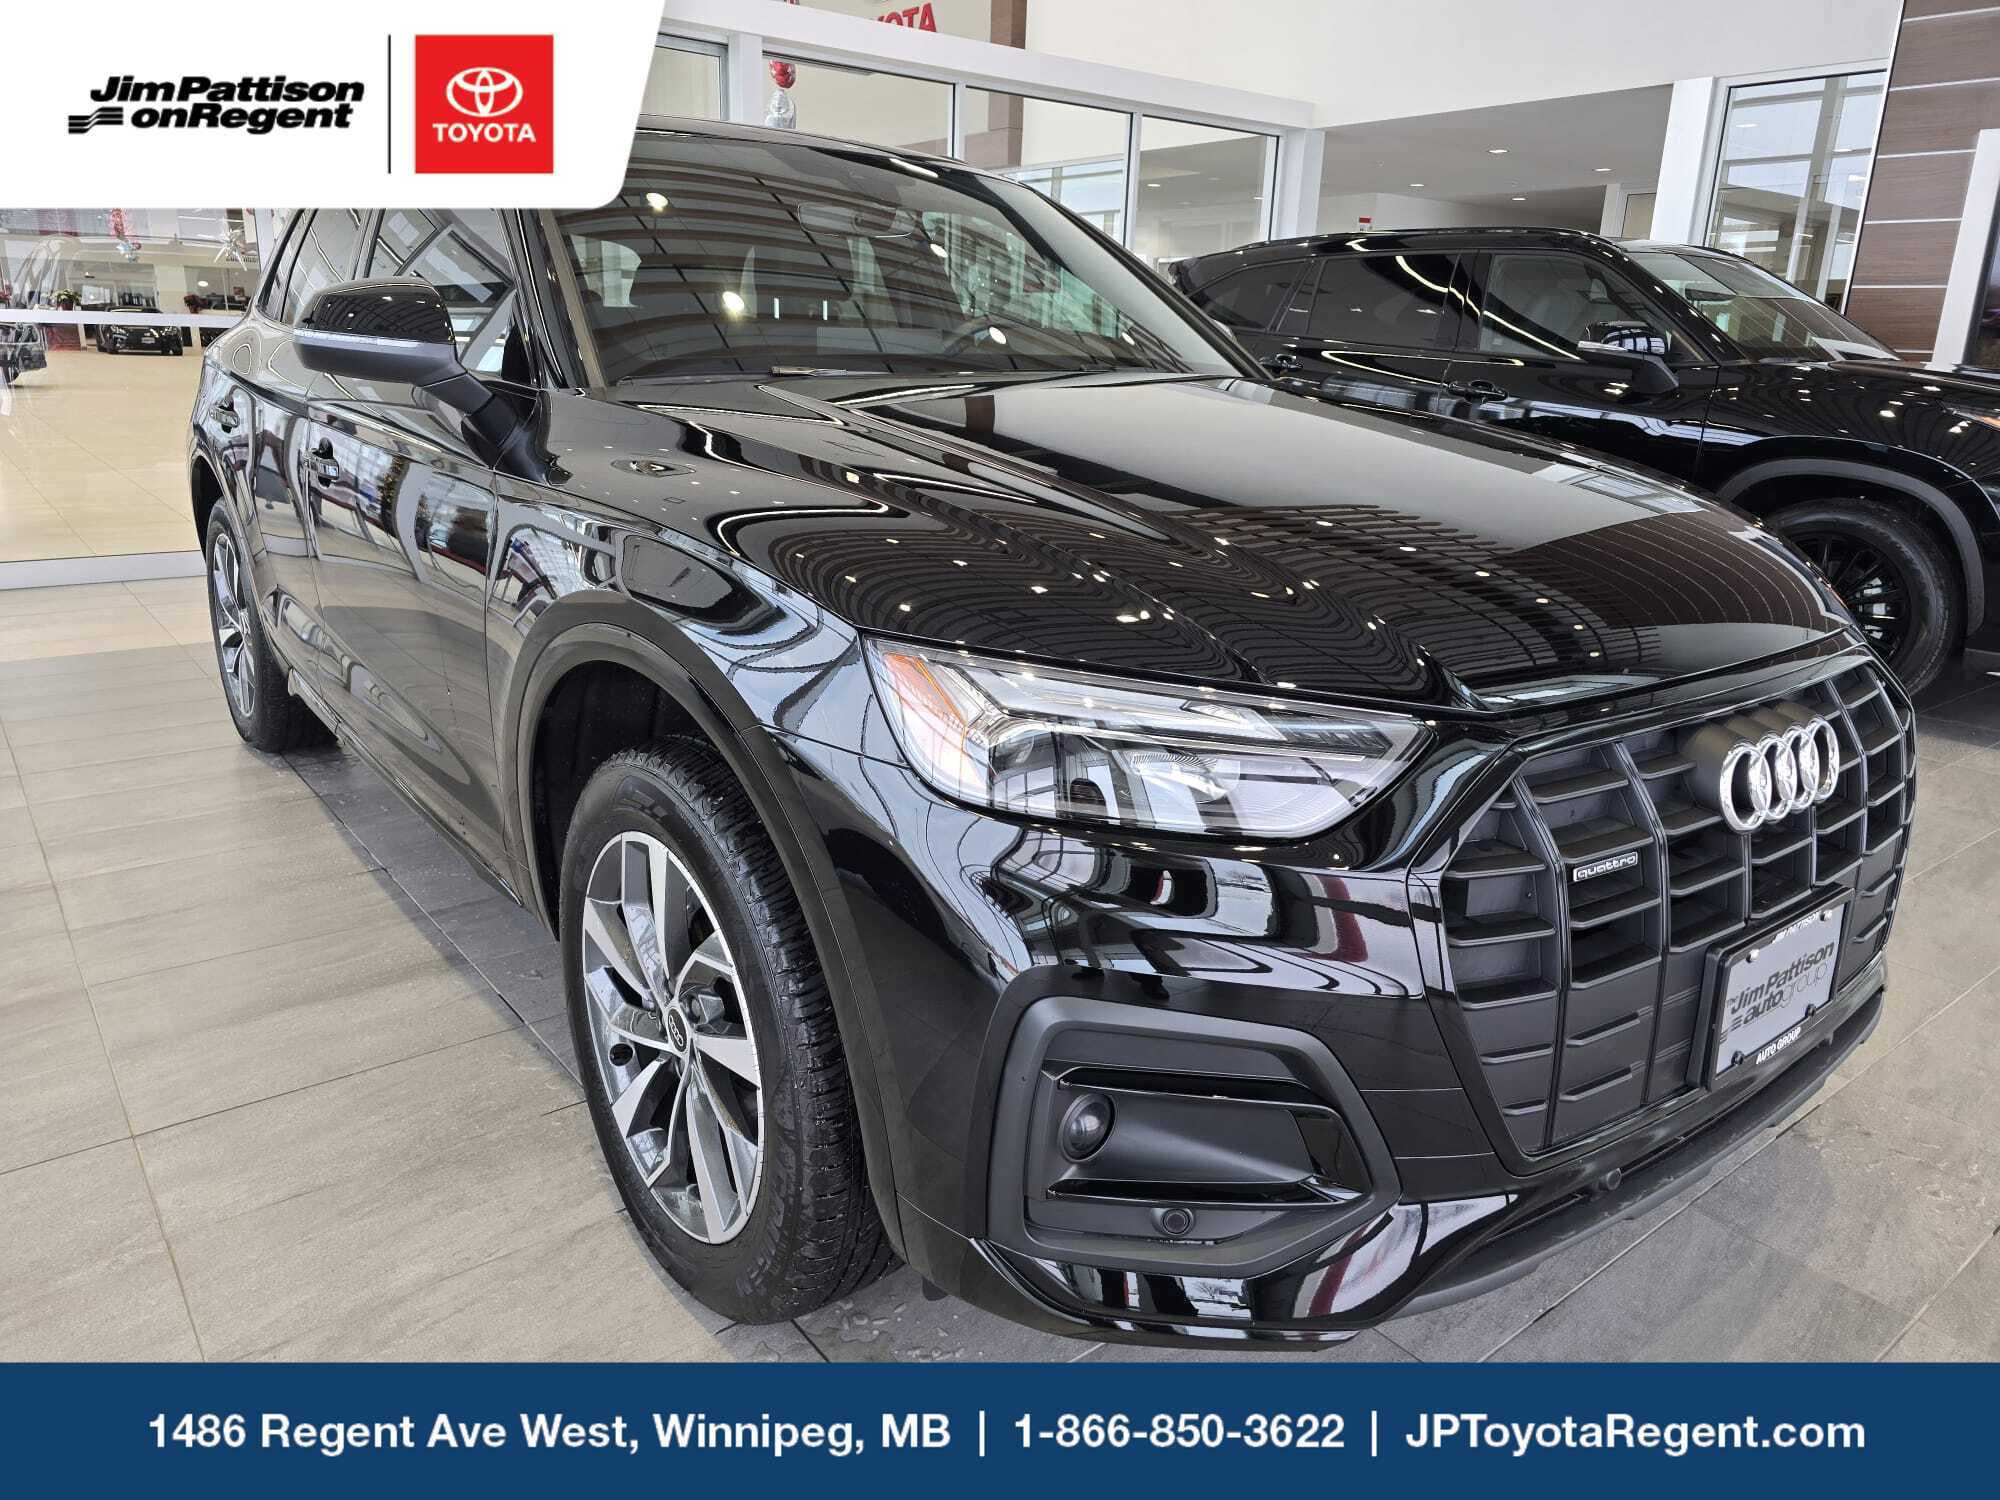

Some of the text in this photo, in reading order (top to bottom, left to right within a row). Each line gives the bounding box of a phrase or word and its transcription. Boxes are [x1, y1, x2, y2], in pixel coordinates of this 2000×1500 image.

[877, 2, 937, 32] OTA
[1577, 855, 1636, 879] quattro
[1755, 1026, 1802, 1065] AUTO GROUP
